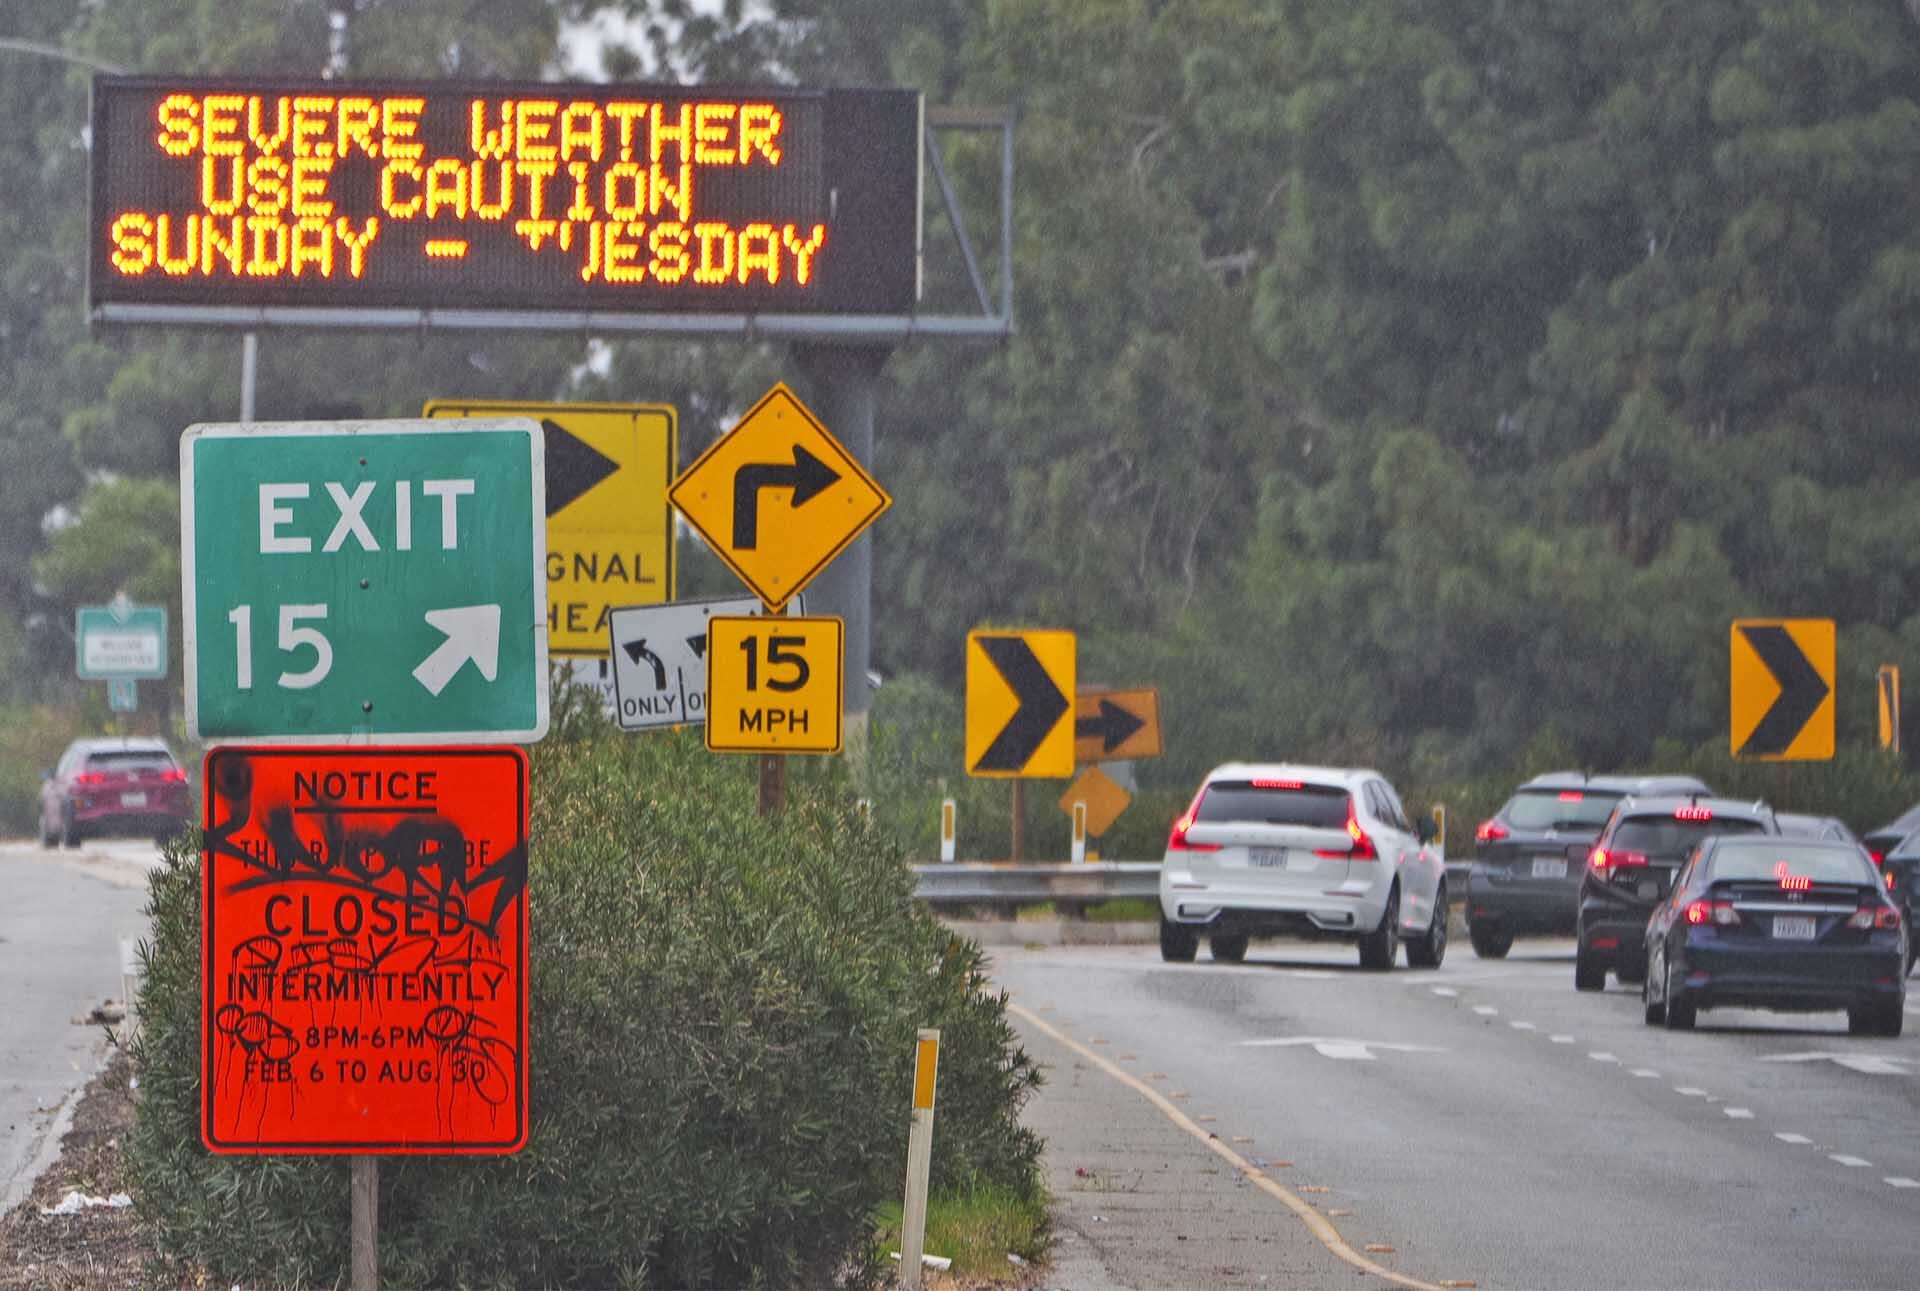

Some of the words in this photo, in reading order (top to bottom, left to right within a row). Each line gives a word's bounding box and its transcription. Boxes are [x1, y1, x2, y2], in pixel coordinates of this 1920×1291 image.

[158, 95, 425, 159] SEVERE
[471, 100, 782, 167] WEATHER
[202, 156, 334, 217] USE
[382, 159, 693, 223] CAUTION
[112, 213, 379, 279] SUNDAY
[425, 239, 469, 259] -
[258, 479, 476, 553] EXIT
[228, 603, 333, 689] 15
[739, 635, 811, 693] 15
[623, 695, 677, 717] ONLY
[739, 709, 809, 734] MPH
[294, 771, 438, 801] NOTICE
[264, 895, 467, 937] CLOSED
[227, 972, 504, 1001] INTERMITTENTLY
[305, 1026, 425, 1049] 8PM-6PM
[309, 1060, 324, 1083] 6
[336, 1060, 367, 1083] TO
[453, 1060, 486, 1083] 30
